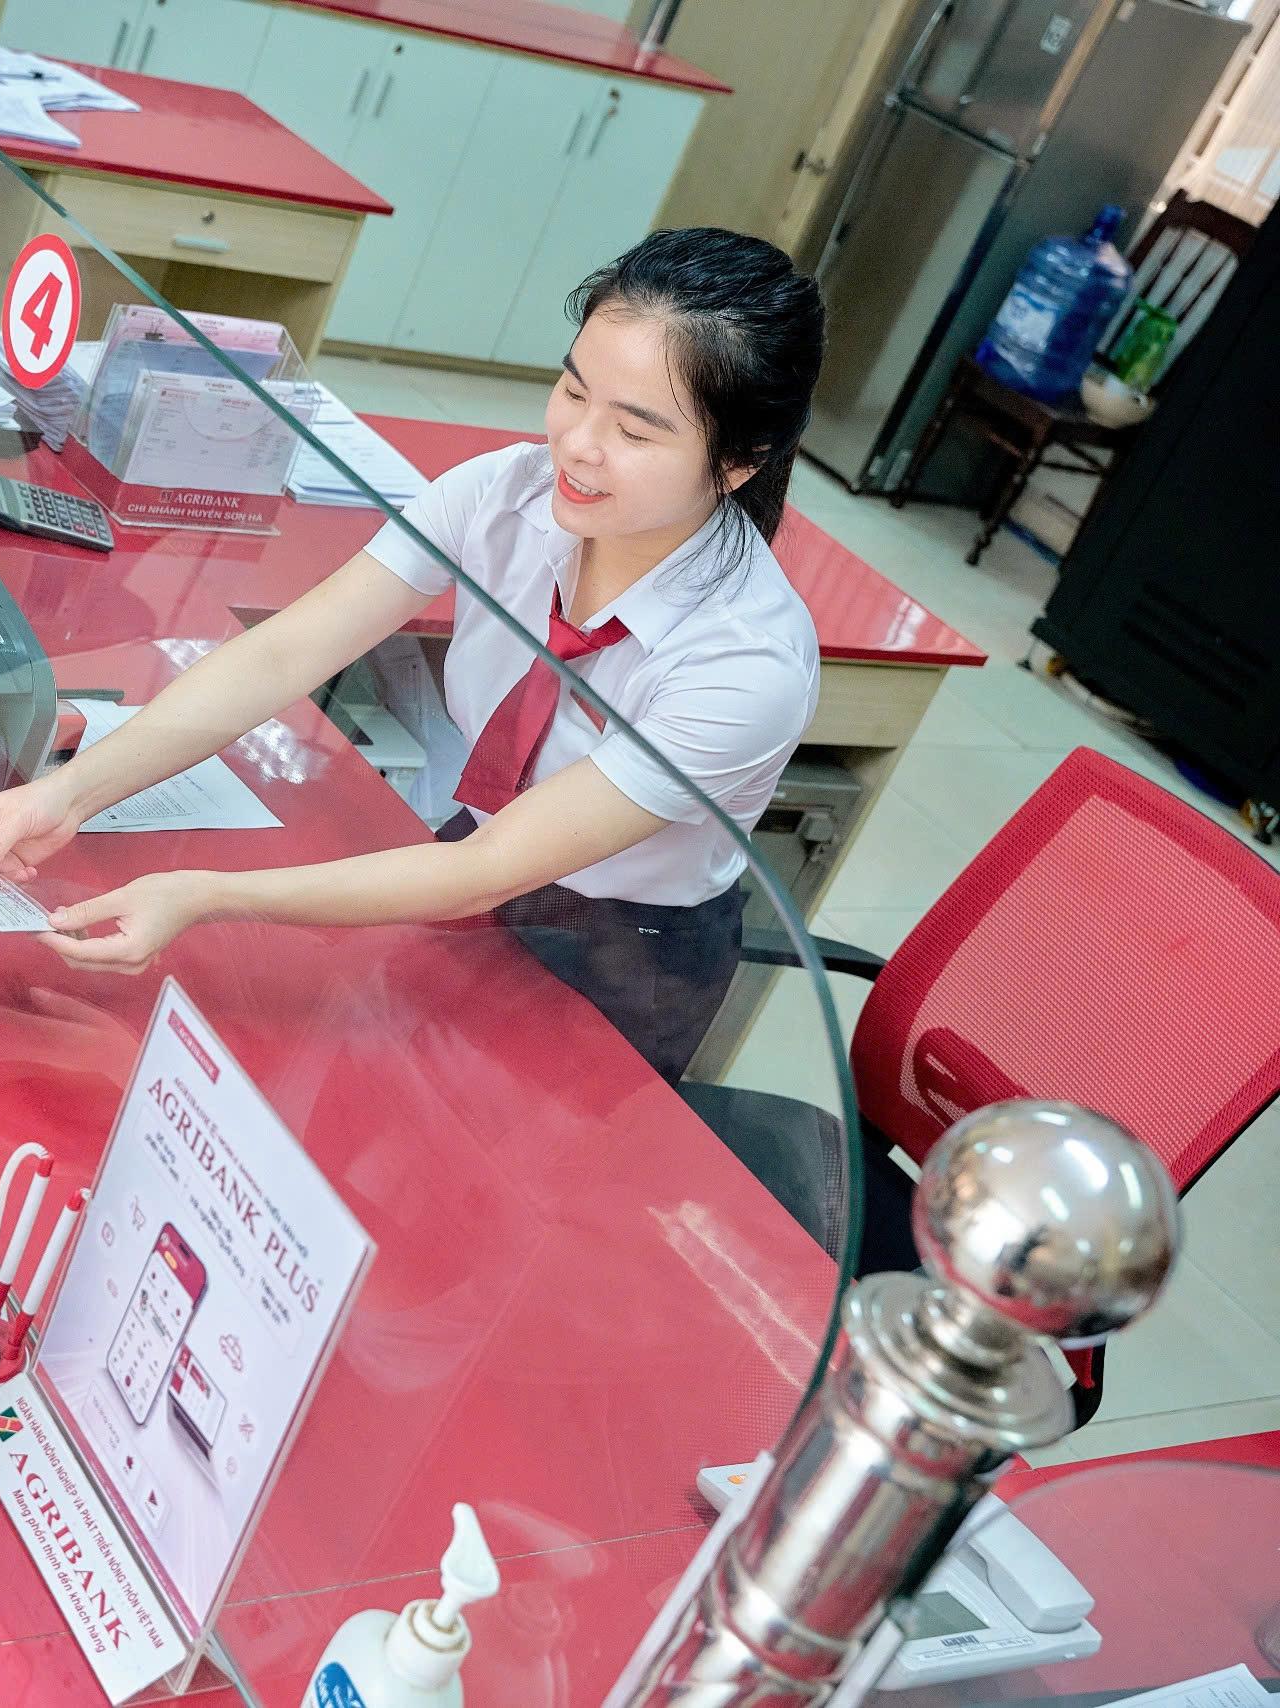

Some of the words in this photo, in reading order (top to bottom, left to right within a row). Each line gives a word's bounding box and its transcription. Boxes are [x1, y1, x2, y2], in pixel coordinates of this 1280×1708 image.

[20, 272, 63, 360] 4
[127, 503, 145, 512] CHI
[148, 505, 185, 516] NHÁNH
[224, 511, 245, 521] SƠN
[248, 513, 263, 522] HÀ
[174, 492, 240, 508] AGRIBANK
[146, 1074, 264, 1238] AGRIBANK
[263, 1228, 320, 1317] PLUS
[14, 1396, 34, 1421] NGÂN
[27, 1418, 47, 1444] HÀNG
[40, 1441, 61, 1468] NÔNG
[54, 1464, 78, 1498] NGHIỆP
[72, 1495, 86, 1511] VÀ
[78, 1508, 98, 1532] PHÁT
[7, 1452, 132, 1651] AGRIBANK
[91, 1530, 112, 1558] TRIỂN
[11, 1489, 33, 1522] Mang
[41, 1543, 62, 1570] thịnh
[56, 1570, 73, 1591] đến
[67, 1590, 92, 1624] khách
[85, 1623, 106, 1654] hàng
[106, 1555, 127, 1584] NÔNG
[120, 1581, 141, 1608] THÔN
[134, 1605, 152, 1628] VIỆT
[145, 1625, 164, 1650] NAM
